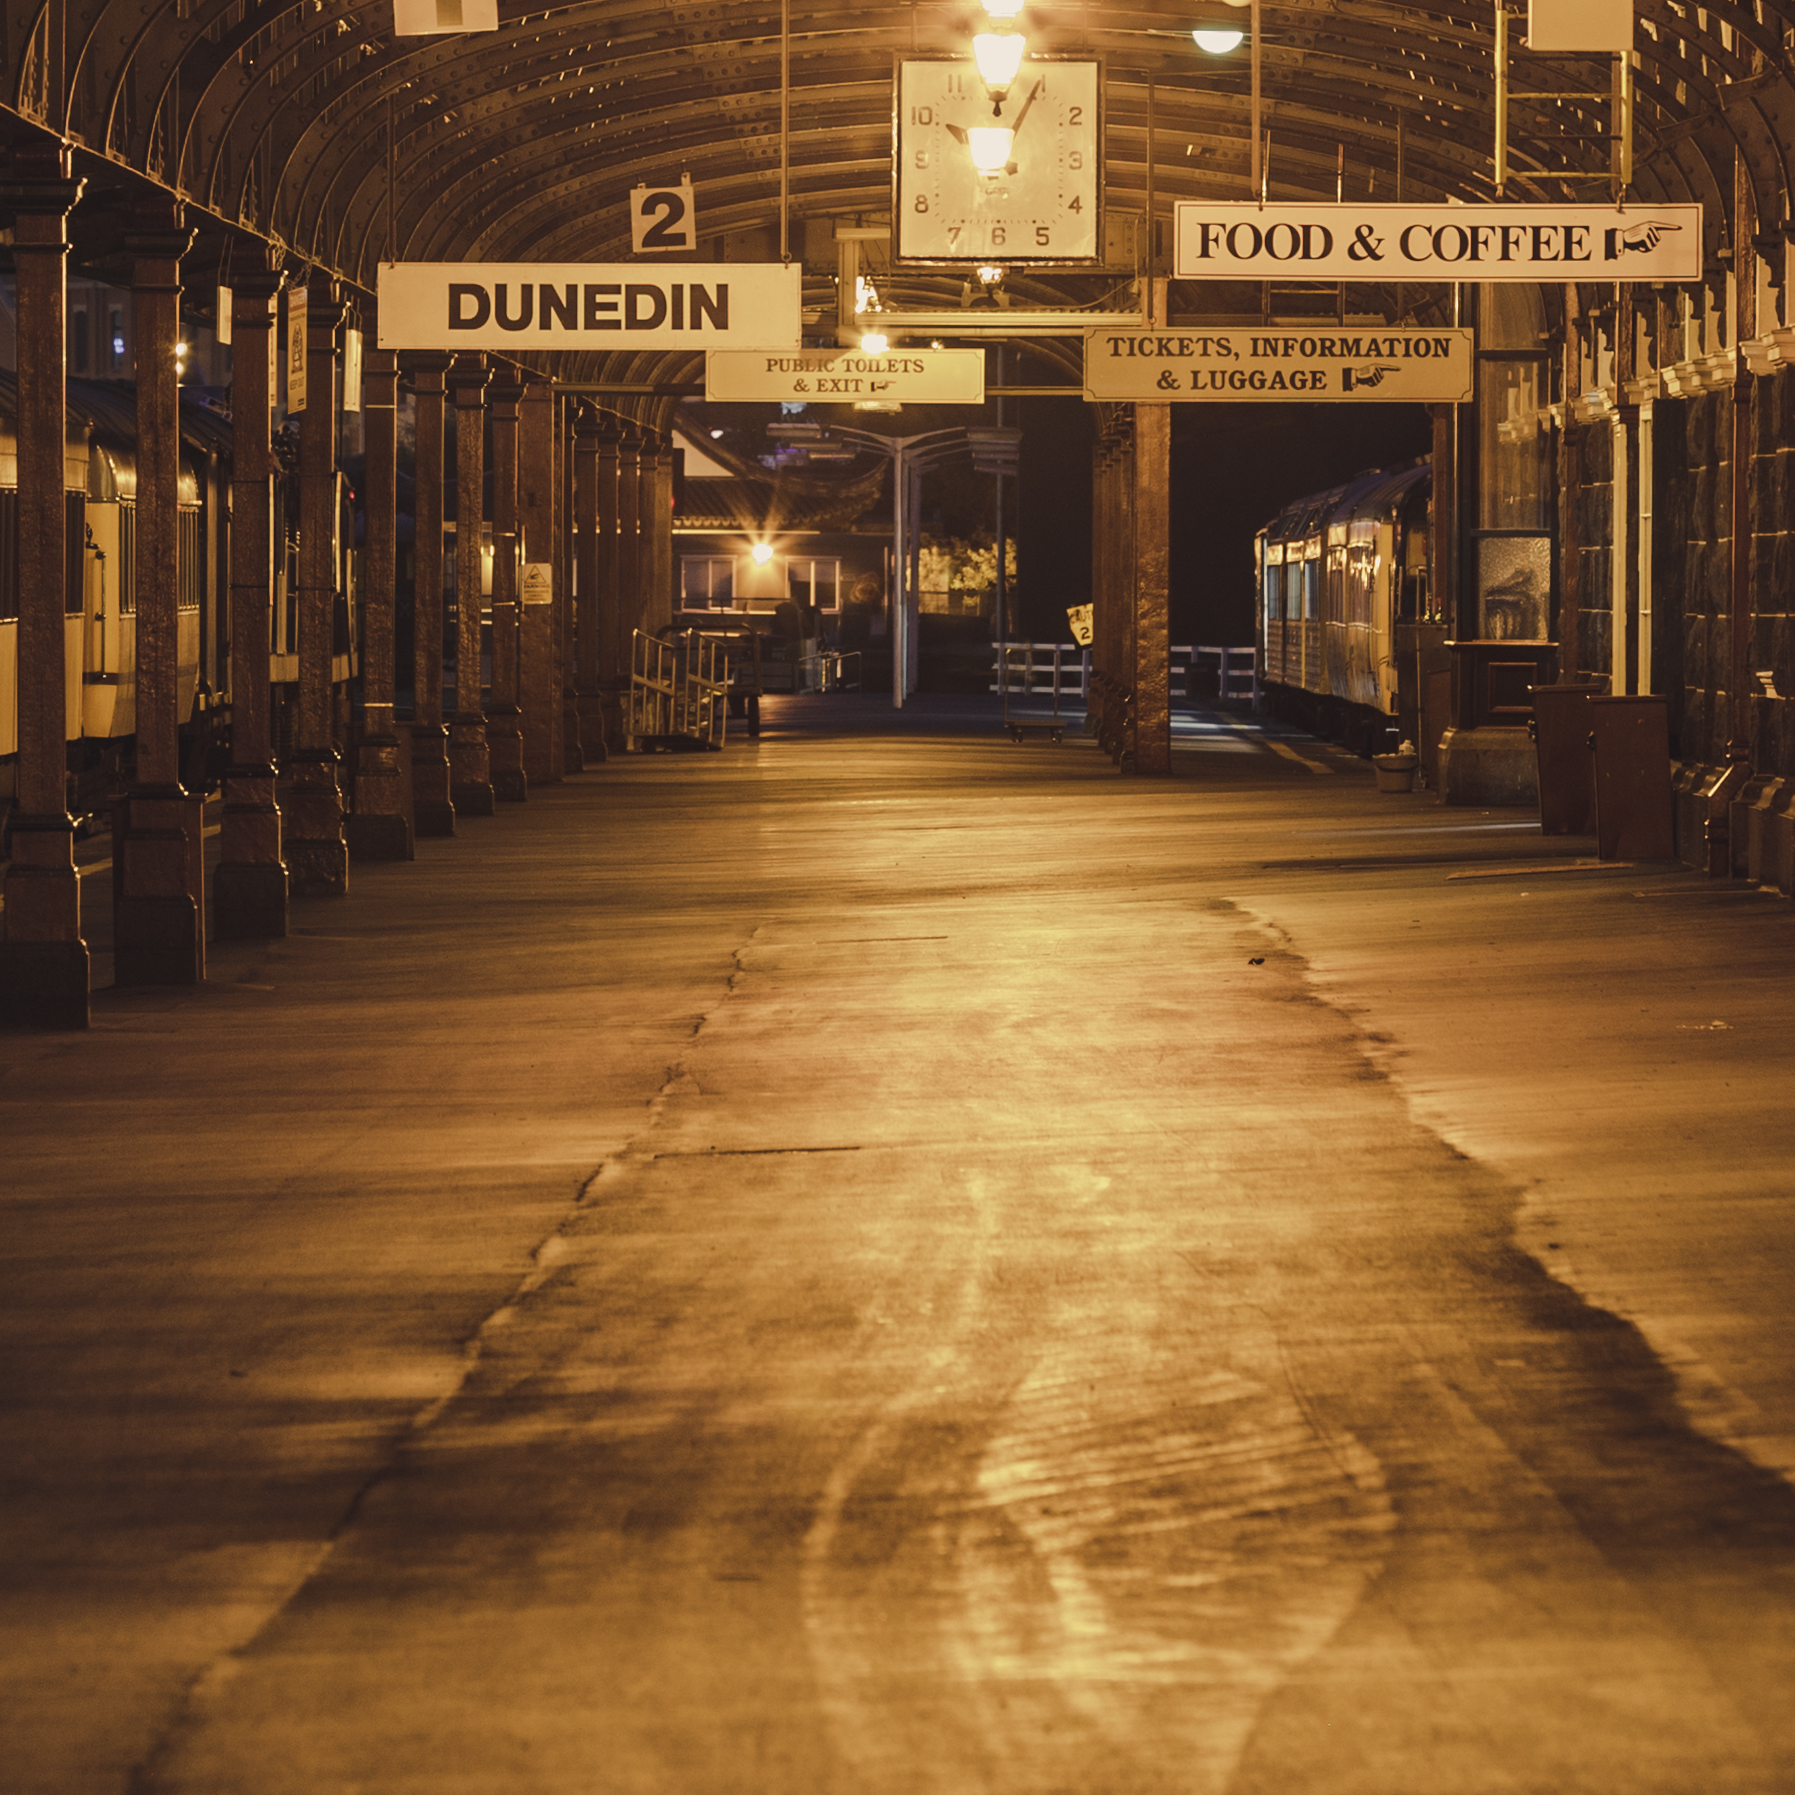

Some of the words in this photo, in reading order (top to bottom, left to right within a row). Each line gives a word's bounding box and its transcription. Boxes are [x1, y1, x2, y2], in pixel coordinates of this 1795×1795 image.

[948, 74, 962, 93] 11
[911, 106, 933, 126] 10
[1068, 106, 1083, 126] 2
[915, 149, 930, 170] 9
[1068, 151, 1083, 170] 3
[914, 194, 929, 214] 8
[1068, 195, 1083, 215] 4
[640, 191, 687, 249] 2
[947, 226, 962, 246] 7
[991, 226, 1006, 246] 6
[1035, 226, 1050, 246] 5
[1196, 222, 1334, 261] FOOD
[1347, 224, 1385, 262] &
[1399, 224, 1592, 262] COFFEE
[447, 282, 729, 332] DUNEDIN
[1106, 336, 1240, 361] TICKETS,
[1249, 337, 1451, 358] INFORMATION
[765, 358, 836, 373] PUBLIC
[841, 358, 925, 374] TOILETS
[792, 378, 811, 393] &
[816, 378, 864, 393] EXIT
[1156, 370, 1181, 391] &
[1190, 369, 1328, 391] LUGGAGE
